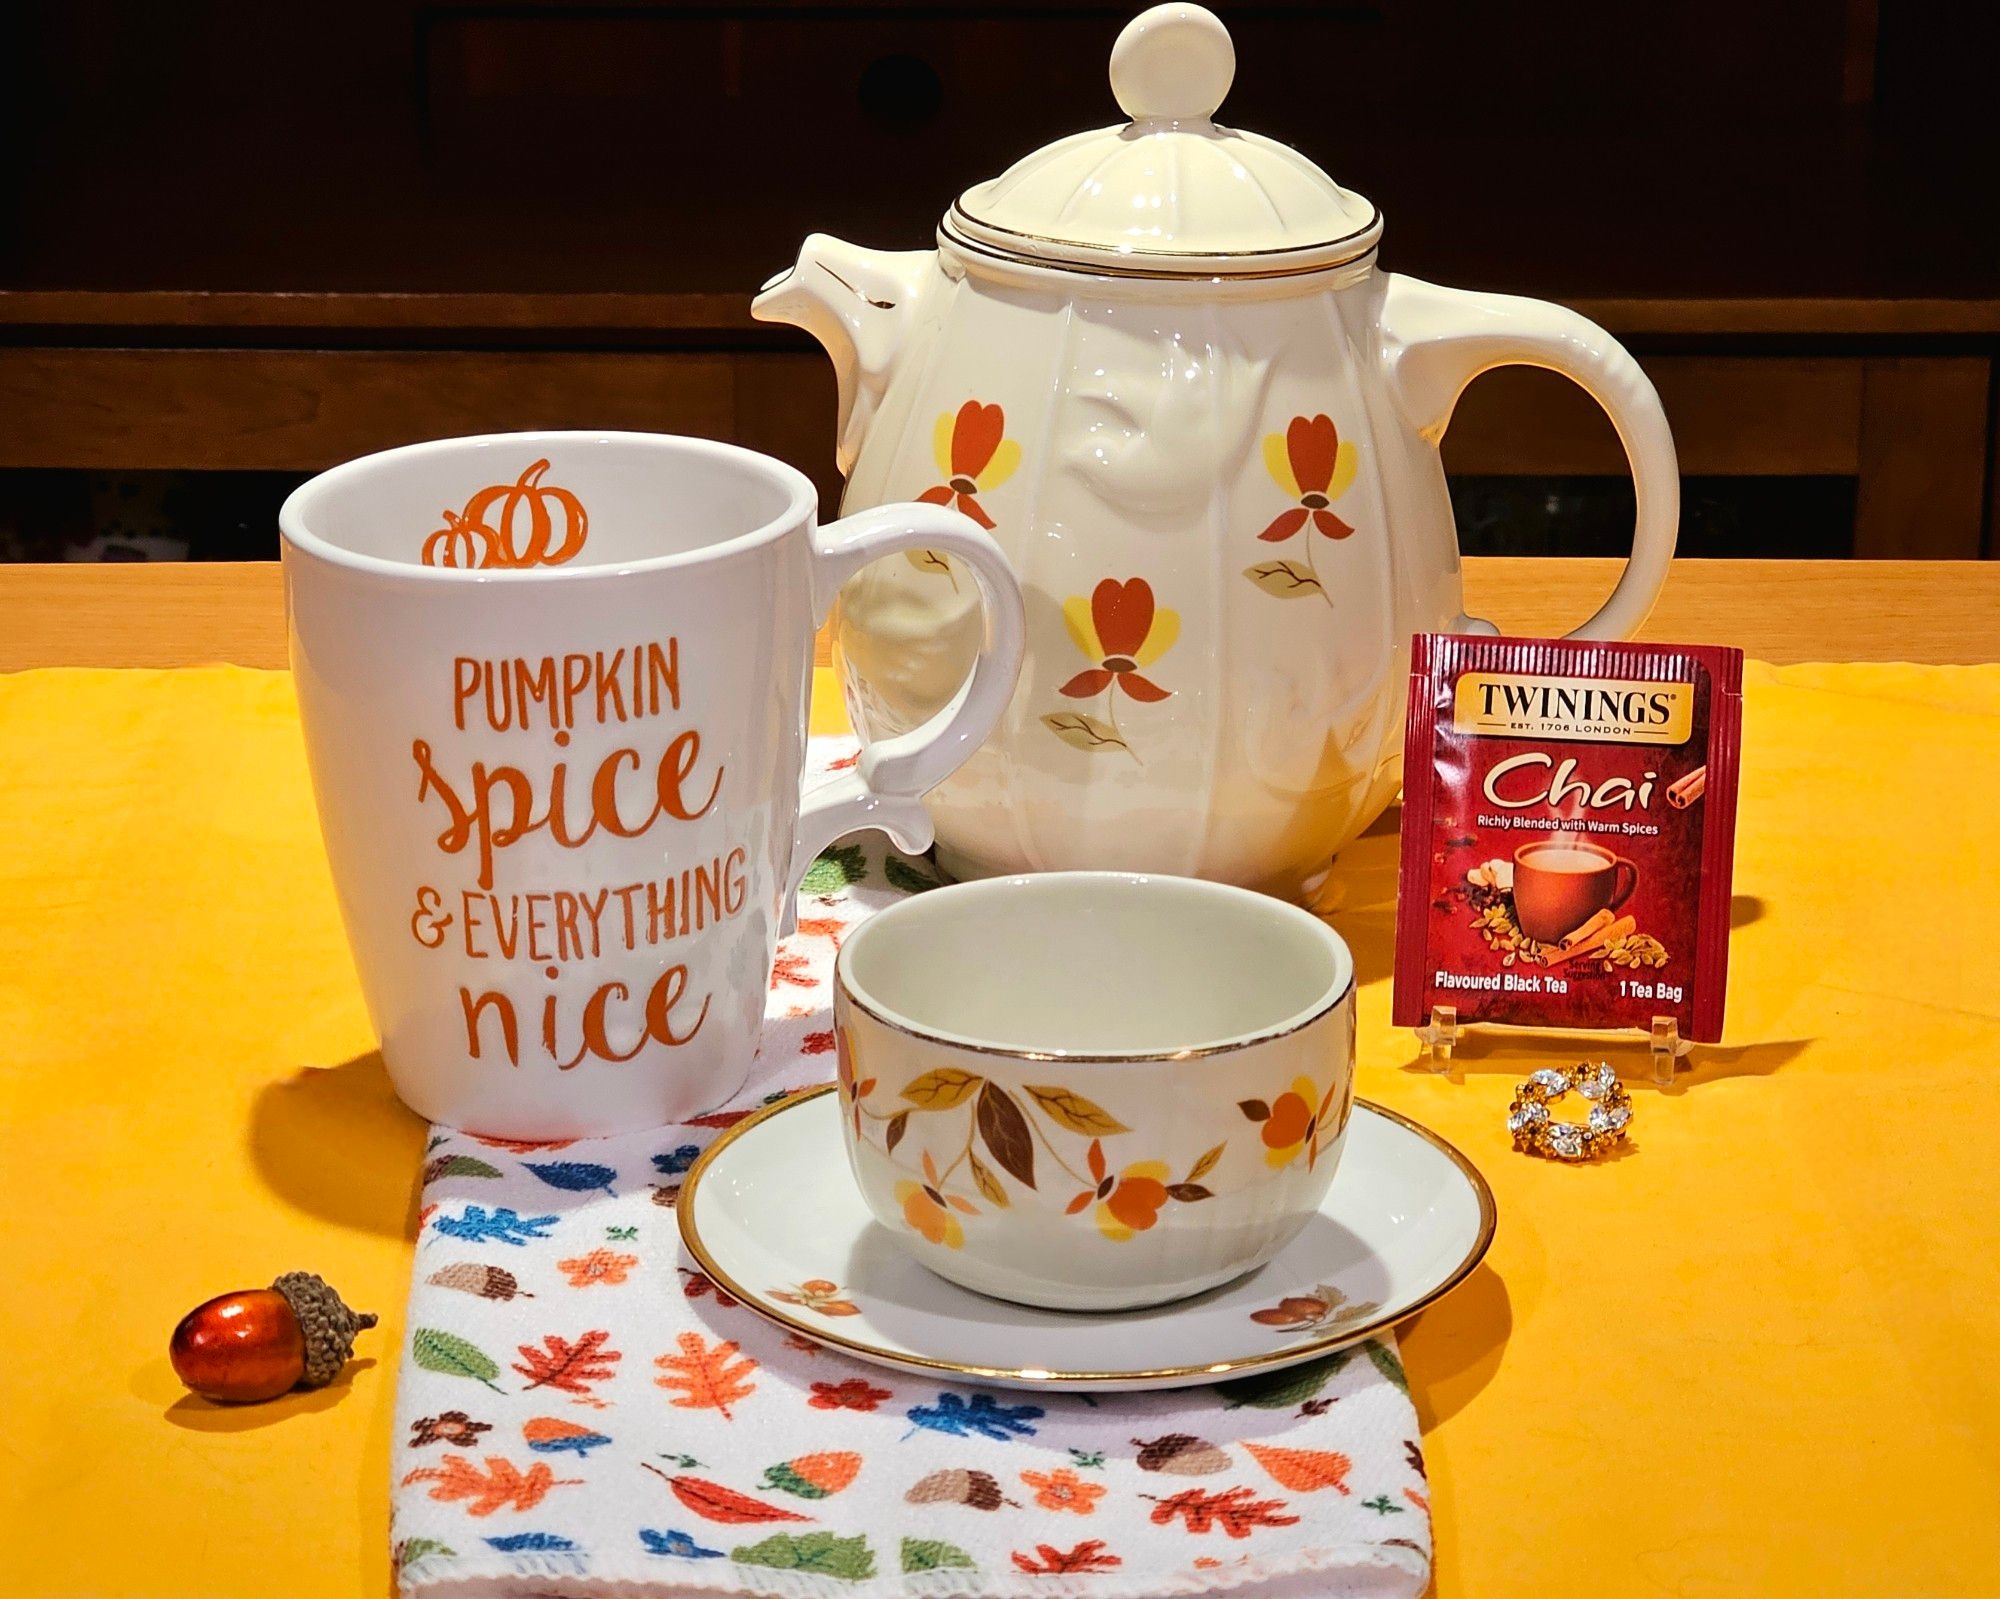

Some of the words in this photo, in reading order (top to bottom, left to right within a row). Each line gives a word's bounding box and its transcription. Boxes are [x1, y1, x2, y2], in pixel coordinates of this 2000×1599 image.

[454, 637, 680, 732] PUMPKIN
[1510, 722, 1534, 731] EST.
[1541, 723, 1570, 732] 1706
[1575, 726, 1632, 736] LONDON
[412, 729, 725, 890] spice
[1483, 752, 1657, 811] Chai
[1477, 815, 1512, 830] Richly
[1513, 816, 1559, 830] Blended
[1561, 819, 1586, 831] with
[1587, 820, 1620, 833] Warm
[1621, 822, 1659, 836] Spices
[410, 885, 454, 950] &
[461, 846, 747, 962] EVERYTHING
[1434, 970, 1501, 990] Flavoured
[1503, 973, 1541, 993] Black
[1543, 976, 1568, 994] Tea
[1619, 980, 1627, 997] 1
[1629, 981, 1653, 998] Tea
[1656, 982, 1683, 1004] Bag
[459, 963, 712, 1071] nice
